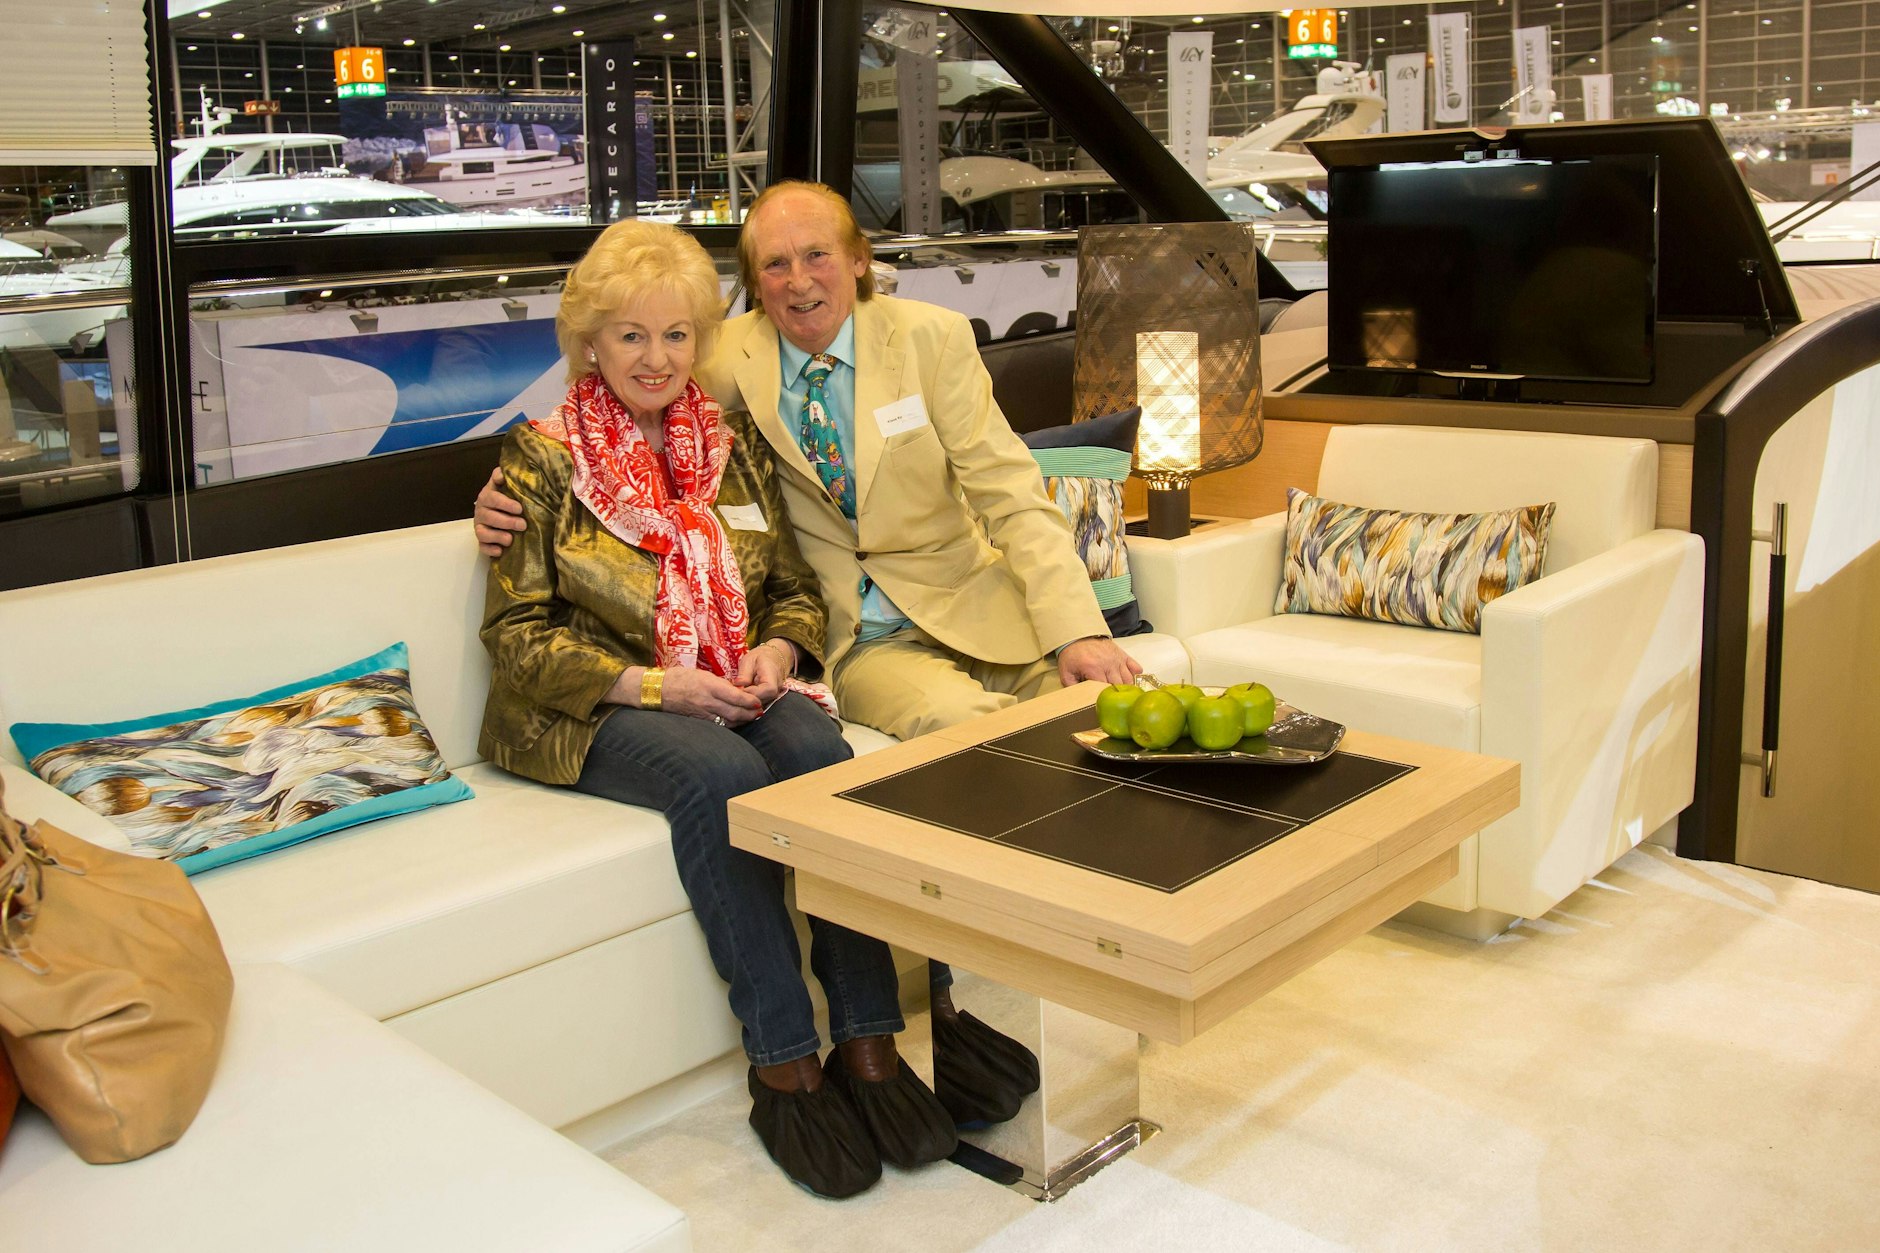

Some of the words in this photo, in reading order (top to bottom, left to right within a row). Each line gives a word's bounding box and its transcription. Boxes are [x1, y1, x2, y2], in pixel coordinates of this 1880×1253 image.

[1297, 19, 1310, 42] 6
[1323, 19, 1332, 42] 6
[340, 60, 348, 81] 6
[361, 58, 375, 81] 6
